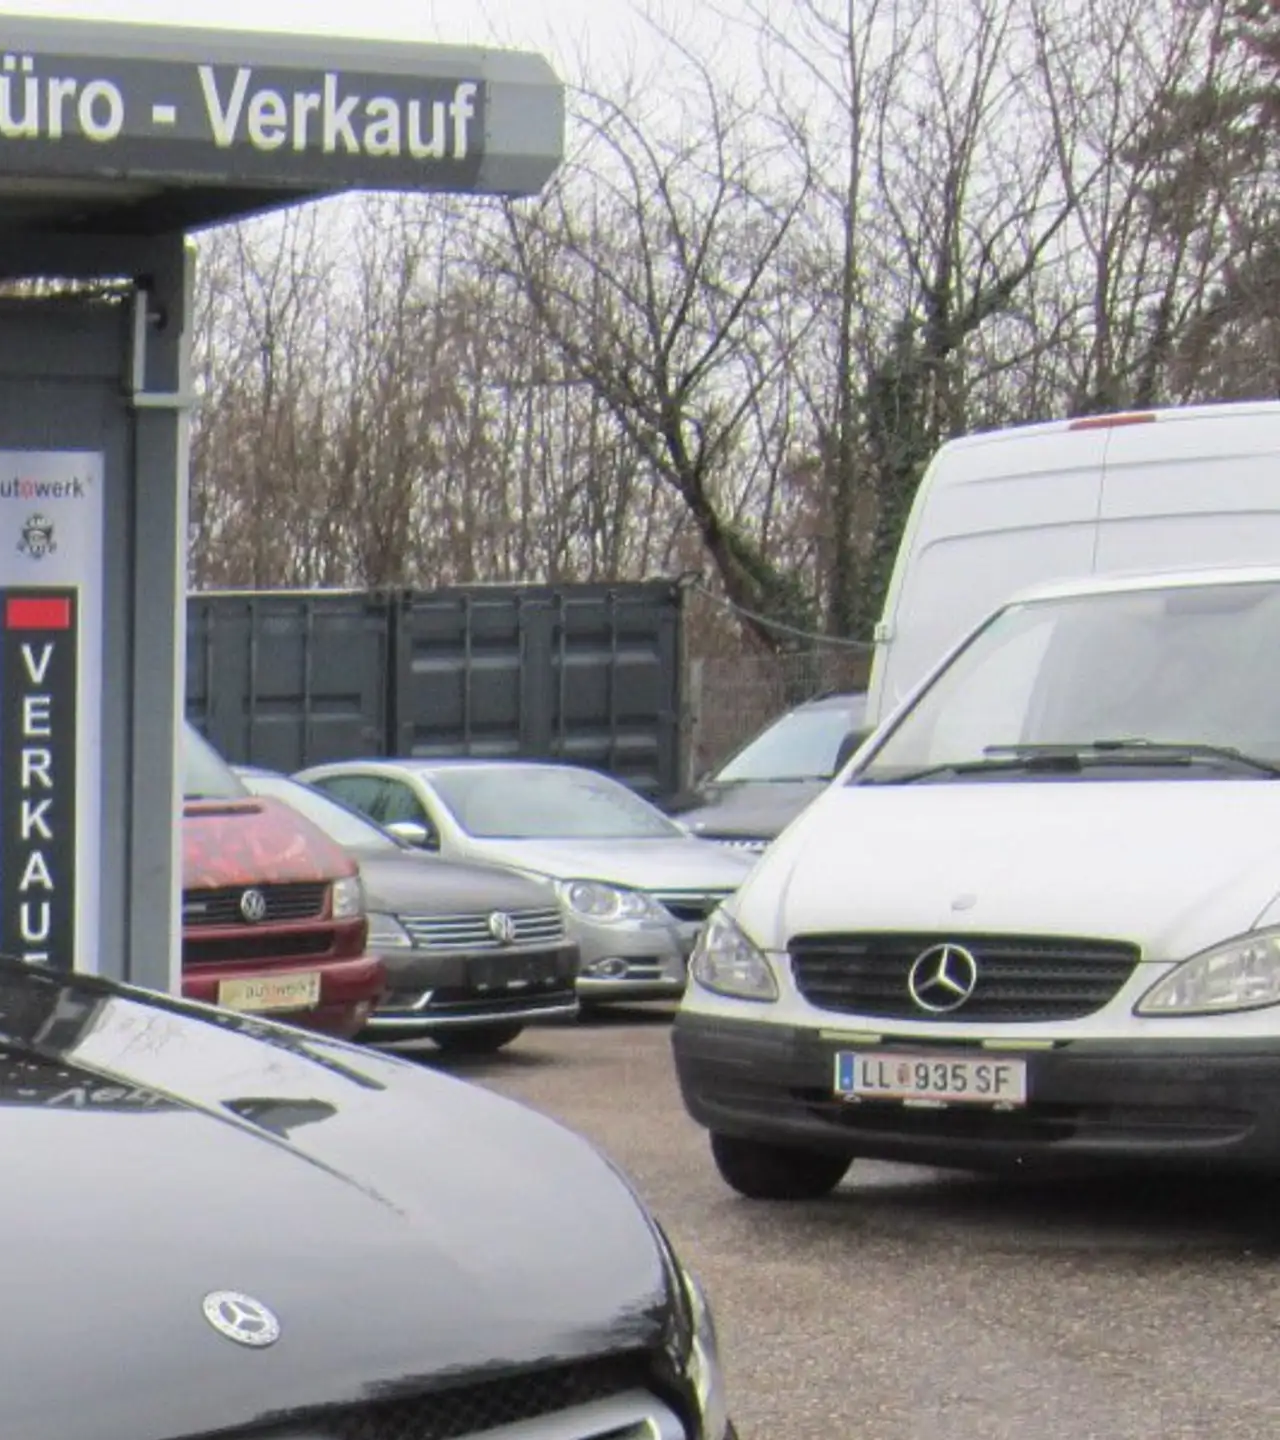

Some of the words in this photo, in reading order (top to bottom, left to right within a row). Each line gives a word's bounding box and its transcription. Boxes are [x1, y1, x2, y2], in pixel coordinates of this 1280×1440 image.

[197, 64, 478, 161] Verkauf
[20, 642, 54, 965] VERKAU
[861, 1060, 891, 1089] LL
[915, 1062, 969, 1093] 935
[975, 1064, 1012, 1094] SF
